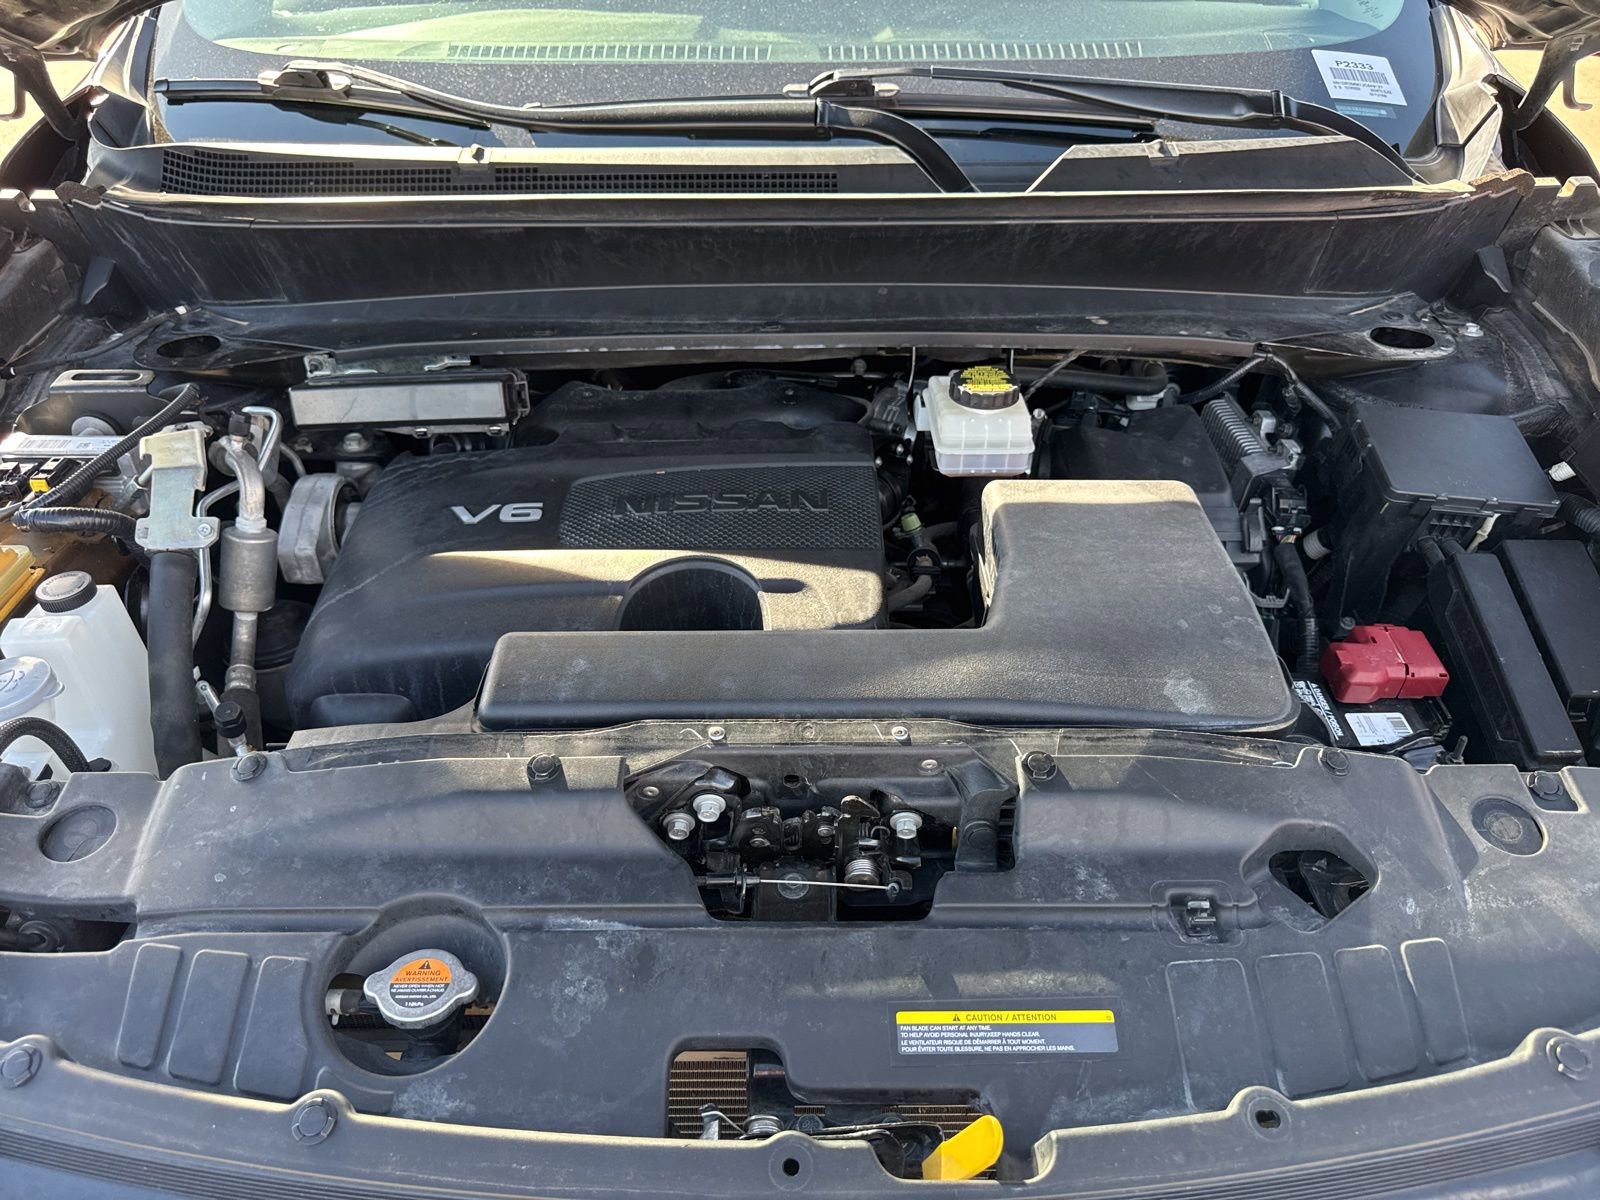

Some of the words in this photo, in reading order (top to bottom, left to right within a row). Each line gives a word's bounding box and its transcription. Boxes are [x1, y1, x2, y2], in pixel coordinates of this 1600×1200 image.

[1335, 60, 1374, 70] P2333
[451, 502, 544, 524] V6
[613, 491, 829, 518] NISSAN
[1314, 688, 1330, 710] DANGER
[1329, 715, 1344, 736] POISON
